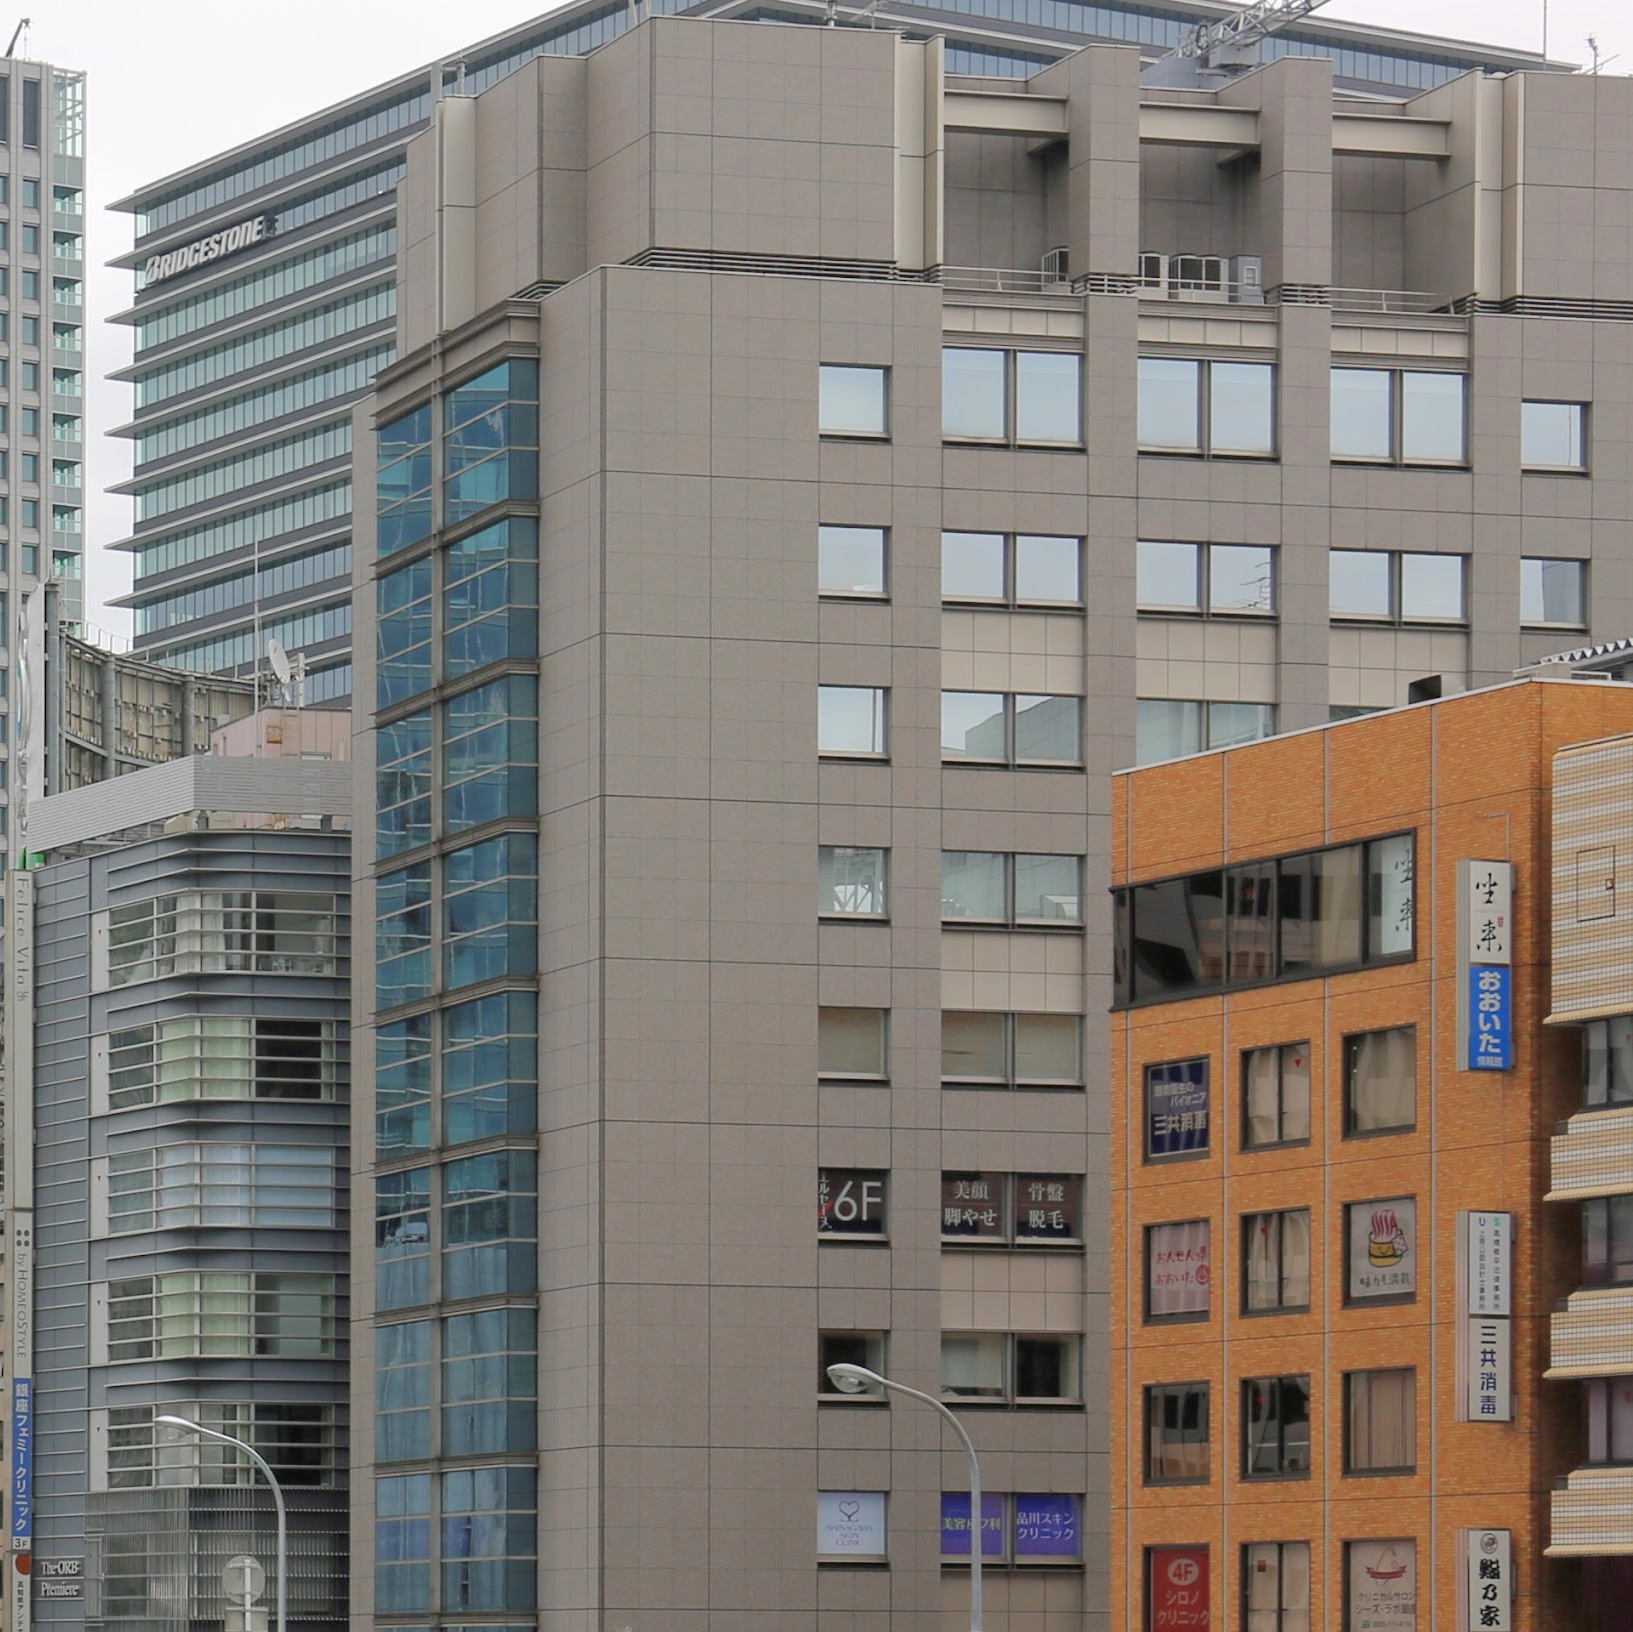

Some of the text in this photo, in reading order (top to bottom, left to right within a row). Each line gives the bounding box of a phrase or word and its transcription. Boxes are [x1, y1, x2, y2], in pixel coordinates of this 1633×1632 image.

[145, 215, 265, 286] BRIDGESTONE
[16, 878, 29, 937] Felice
[16, 946, 29, 985] Vita
[1478, 970, 1502, 1053] おおいた
[1170, 1092, 1207, 1107] パイオニア
[1154, 1109, 1207, 1135] 三共消毒
[952, 1179, 989, 1201] 美顔
[1028, 1182, 1064, 1202] 骨盤
[834, 1180, 882, 1222] 6F
[943, 1208, 997, 1227] 脚やせ
[1028, 1209, 1064, 1229] 脱毛
[15, 1253, 28, 1267] by
[1155, 1245, 1207, 1265] おんせん県
[1480, 1325, 1497, 1415] 三共消毒
[15, 1383, 30, 1532] 銀座フェミークリニック
[1016, 1512, 1074, 1525] 品川スキン
[14, 1538, 27, 1548] 3F
[1017, 1527, 1075, 1540] クリニック
[41, 1560, 56, 1575] The
[1172, 1562, 1194, 1581] 4F
[1165, 1589, 1200, 1606] シロノ
[1157, 1609, 1209, 1626] クリニック
